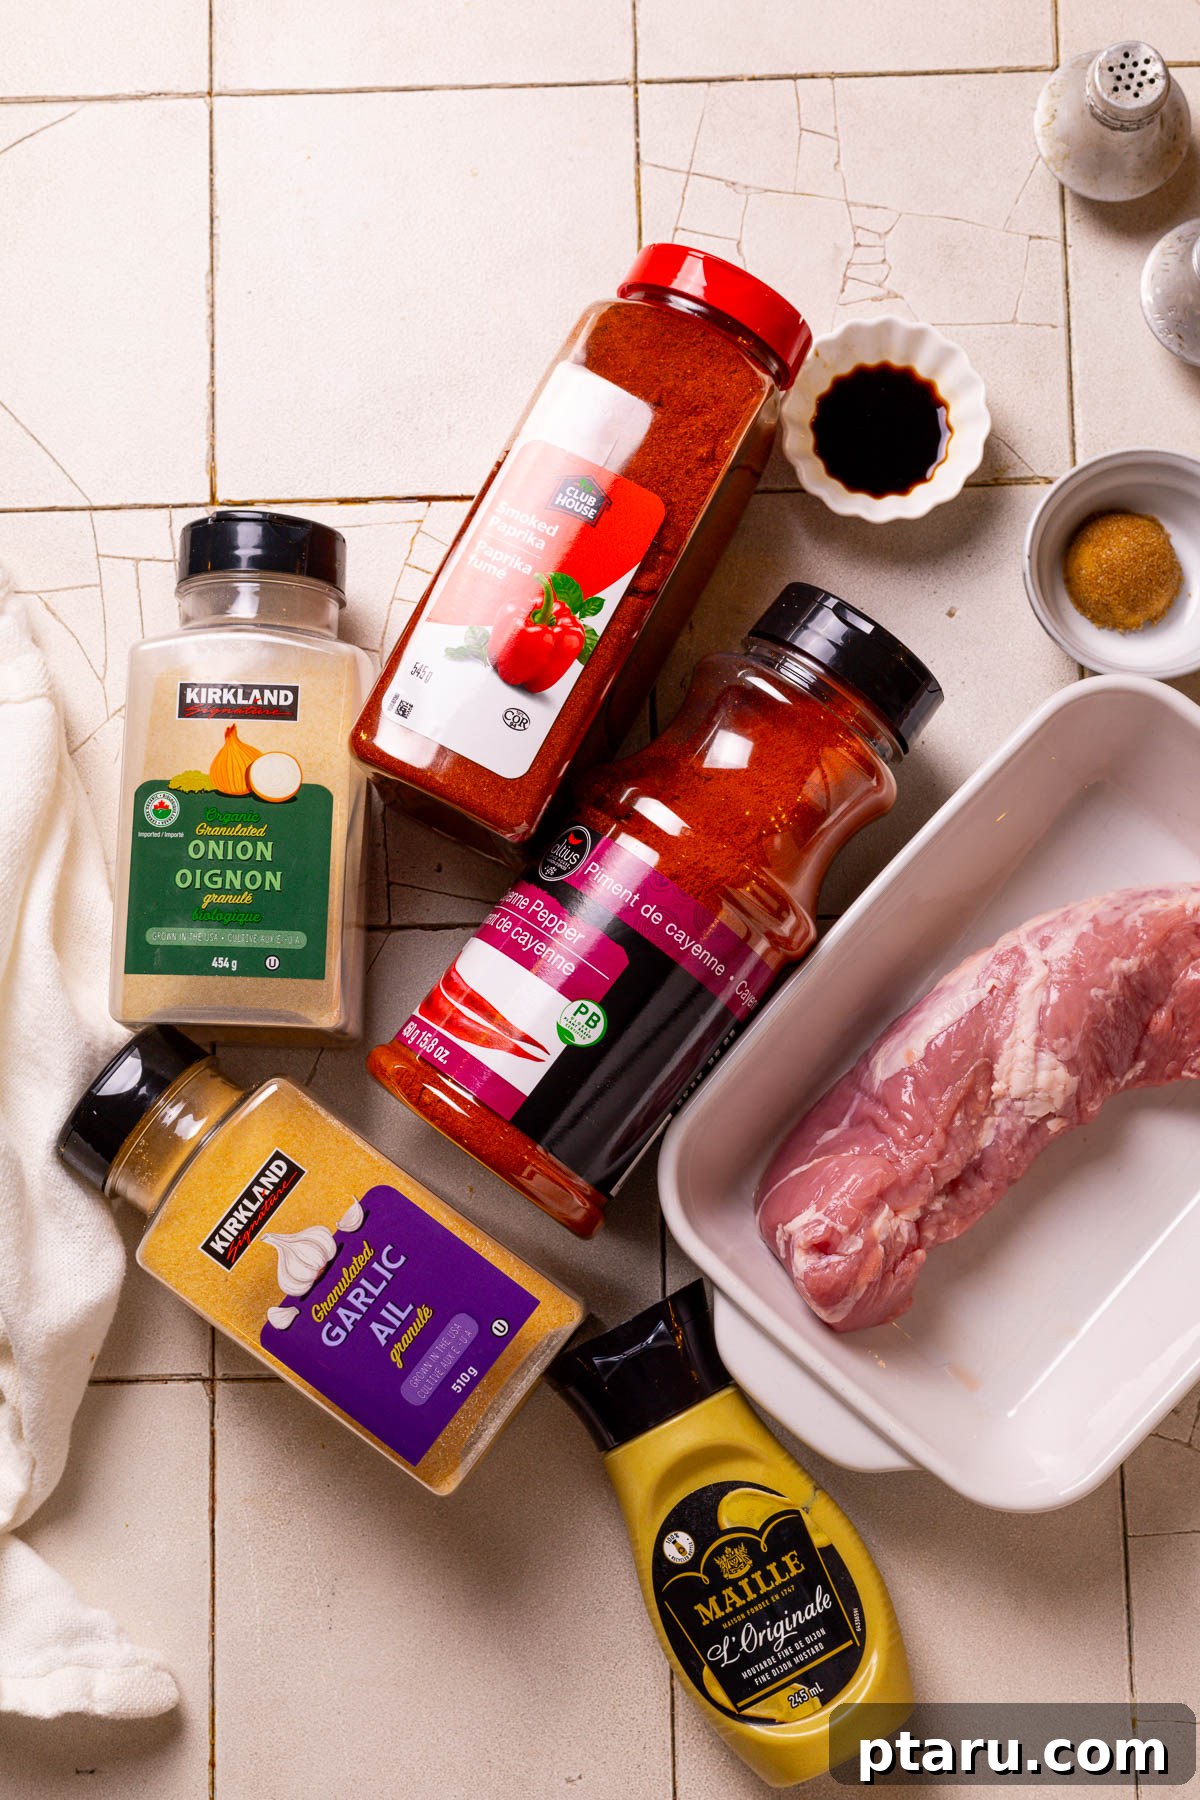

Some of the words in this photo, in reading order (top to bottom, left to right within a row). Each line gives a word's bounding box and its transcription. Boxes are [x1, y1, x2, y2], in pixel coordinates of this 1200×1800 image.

[555, 493, 597, 519] HOUSE
[566, 486, 596, 506] CLUB
[488, 514, 546, 550] Paprika
[495, 501, 559, 537] Smoked
[475, 540, 533, 575] Paprika
[184, 703, 293, 719] Signature
[185, 687, 294, 706] KIRKLAND
[504, 710, 529, 730] COR
[195, 822, 267, 837] Granulated
[205, 807, 260, 824] Organic
[188, 839, 274, 861] ONION
[175, 868, 282, 890] OIGNON
[191, 907, 262, 925] biologique
[201, 891, 253, 909] granulé
[528, 900, 585, 944] Pepper
[584, 861, 640, 907] Piment
[640, 904, 663, 924] de
[665, 923, 725, 976] cayenne
[151, 931, 177, 941] GROWN
[179, 932, 187, 941] IN
[189, 932, 203, 942] THE
[205, 933, 219, 943] USA
[495, 915, 512, 933] de
[511, 926, 576, 976] cayenne
[212, 956, 230, 969] 454
[231, 959, 238, 971] g
[416, 1030, 439, 1053] 15.8
[209, 1159, 288, 1254] KIRKLAND
[226, 1171, 297, 1264] Signature
[311, 1240, 375, 1323] Granulated
[321, 1244, 407, 1347] GARLIC
[369, 1301, 414, 1347] AIL
[390, 1303, 433, 1369] granulé
[409, 1362, 433, 1388] GROWN
[429, 1352, 440, 1363] IN
[435, 1336, 451, 1353] THE
[447, 1323, 461, 1339] USA
[451, 1372, 470, 1393] 510
[467, 1366, 478, 1377] g
[694, 1550, 806, 1626] MAILLE
[722, 1613, 746, 1630] MAISON
[770, 1593, 780, 1602] EN
[780, 1584, 796, 1597] 1747
[707, 1584, 832, 1668] L'Originale
[741, 1655, 777, 1679] MOUTARDE
[777, 1646, 794, 1660] FINE
[794, 1640, 805, 1650] DE
[804, 1627, 827, 1644] DIJON
[754, 1672, 771, 1686] FINE
[771, 1660, 793, 1677] DIJON
[792, 1642, 825, 1665] MUSTARD
[788, 1689, 809, 1708] 245
[809, 1681, 824, 1697] mL
